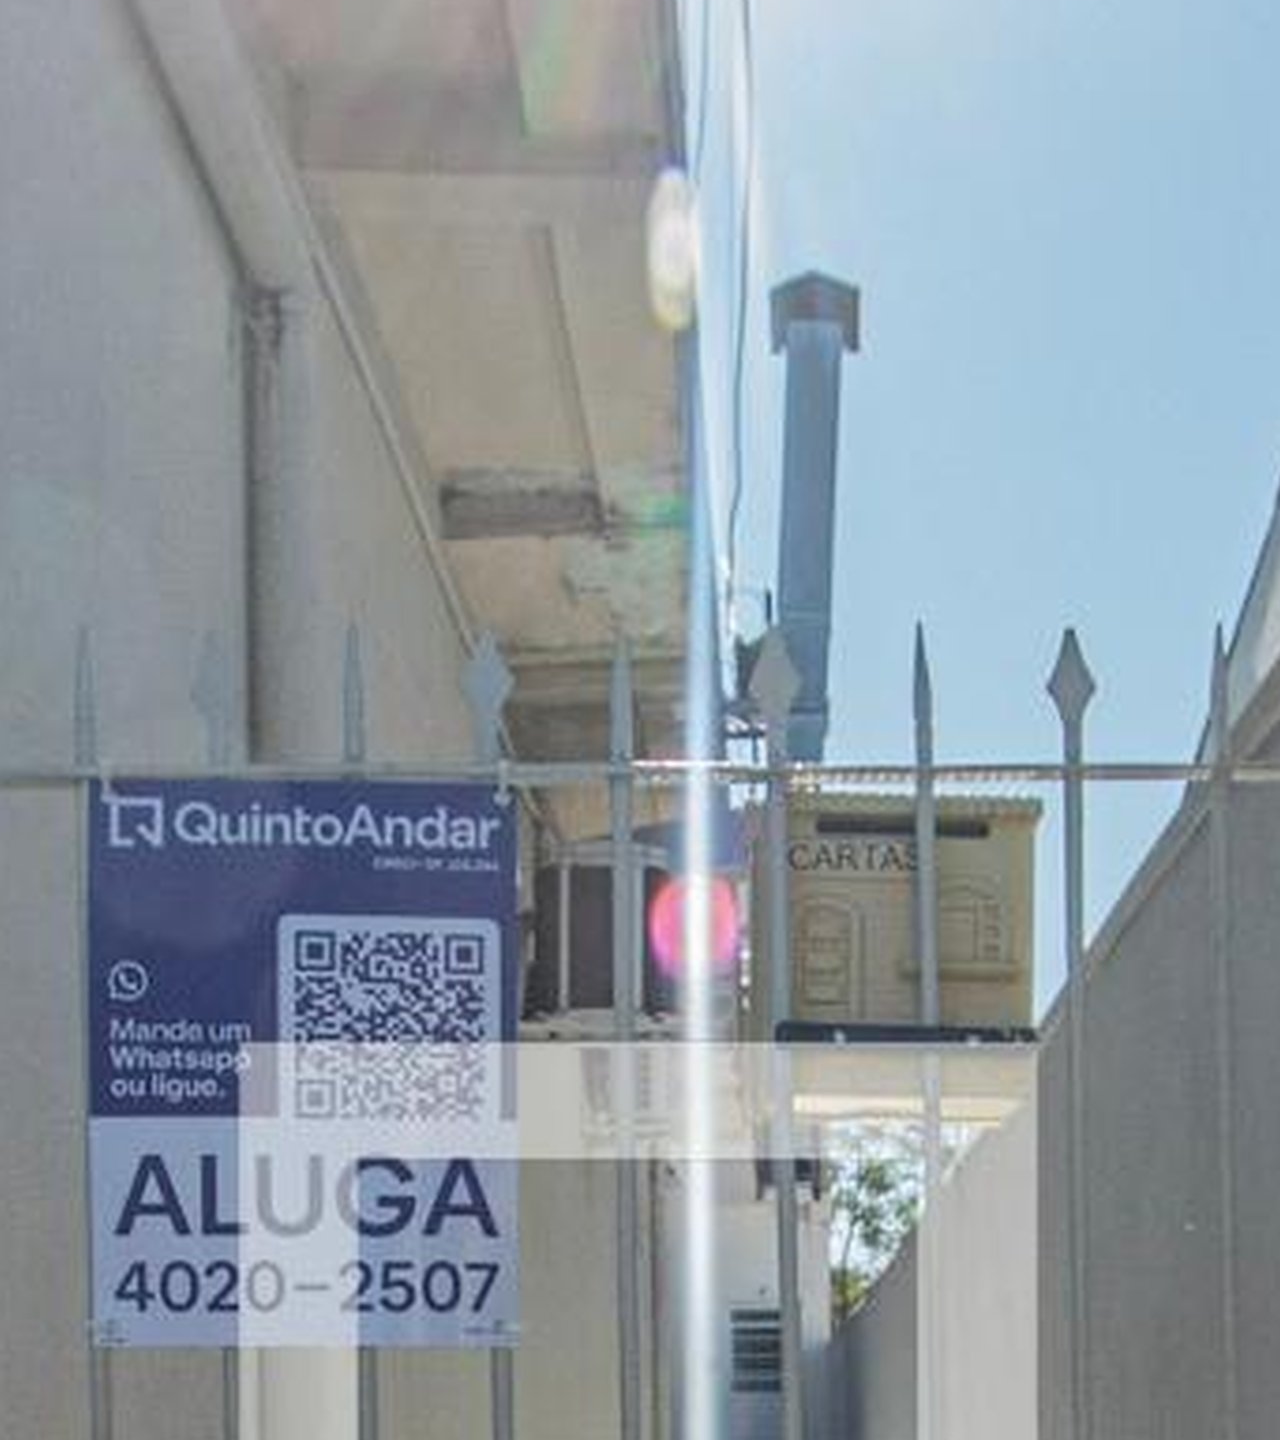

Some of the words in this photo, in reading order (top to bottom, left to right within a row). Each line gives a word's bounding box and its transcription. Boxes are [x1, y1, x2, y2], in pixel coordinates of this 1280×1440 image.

[174, 803, 501, 849] QuintoAndar
[788, 841, 918, 871] CARTAS
[109, 1018, 203, 1042] Manda
[208, 1023, 252, 1043] um
[110, 1078, 146, 1098] ou
[150, 1072, 226, 1103] ligue.
[114, 1154, 501, 1239] ALUGA
